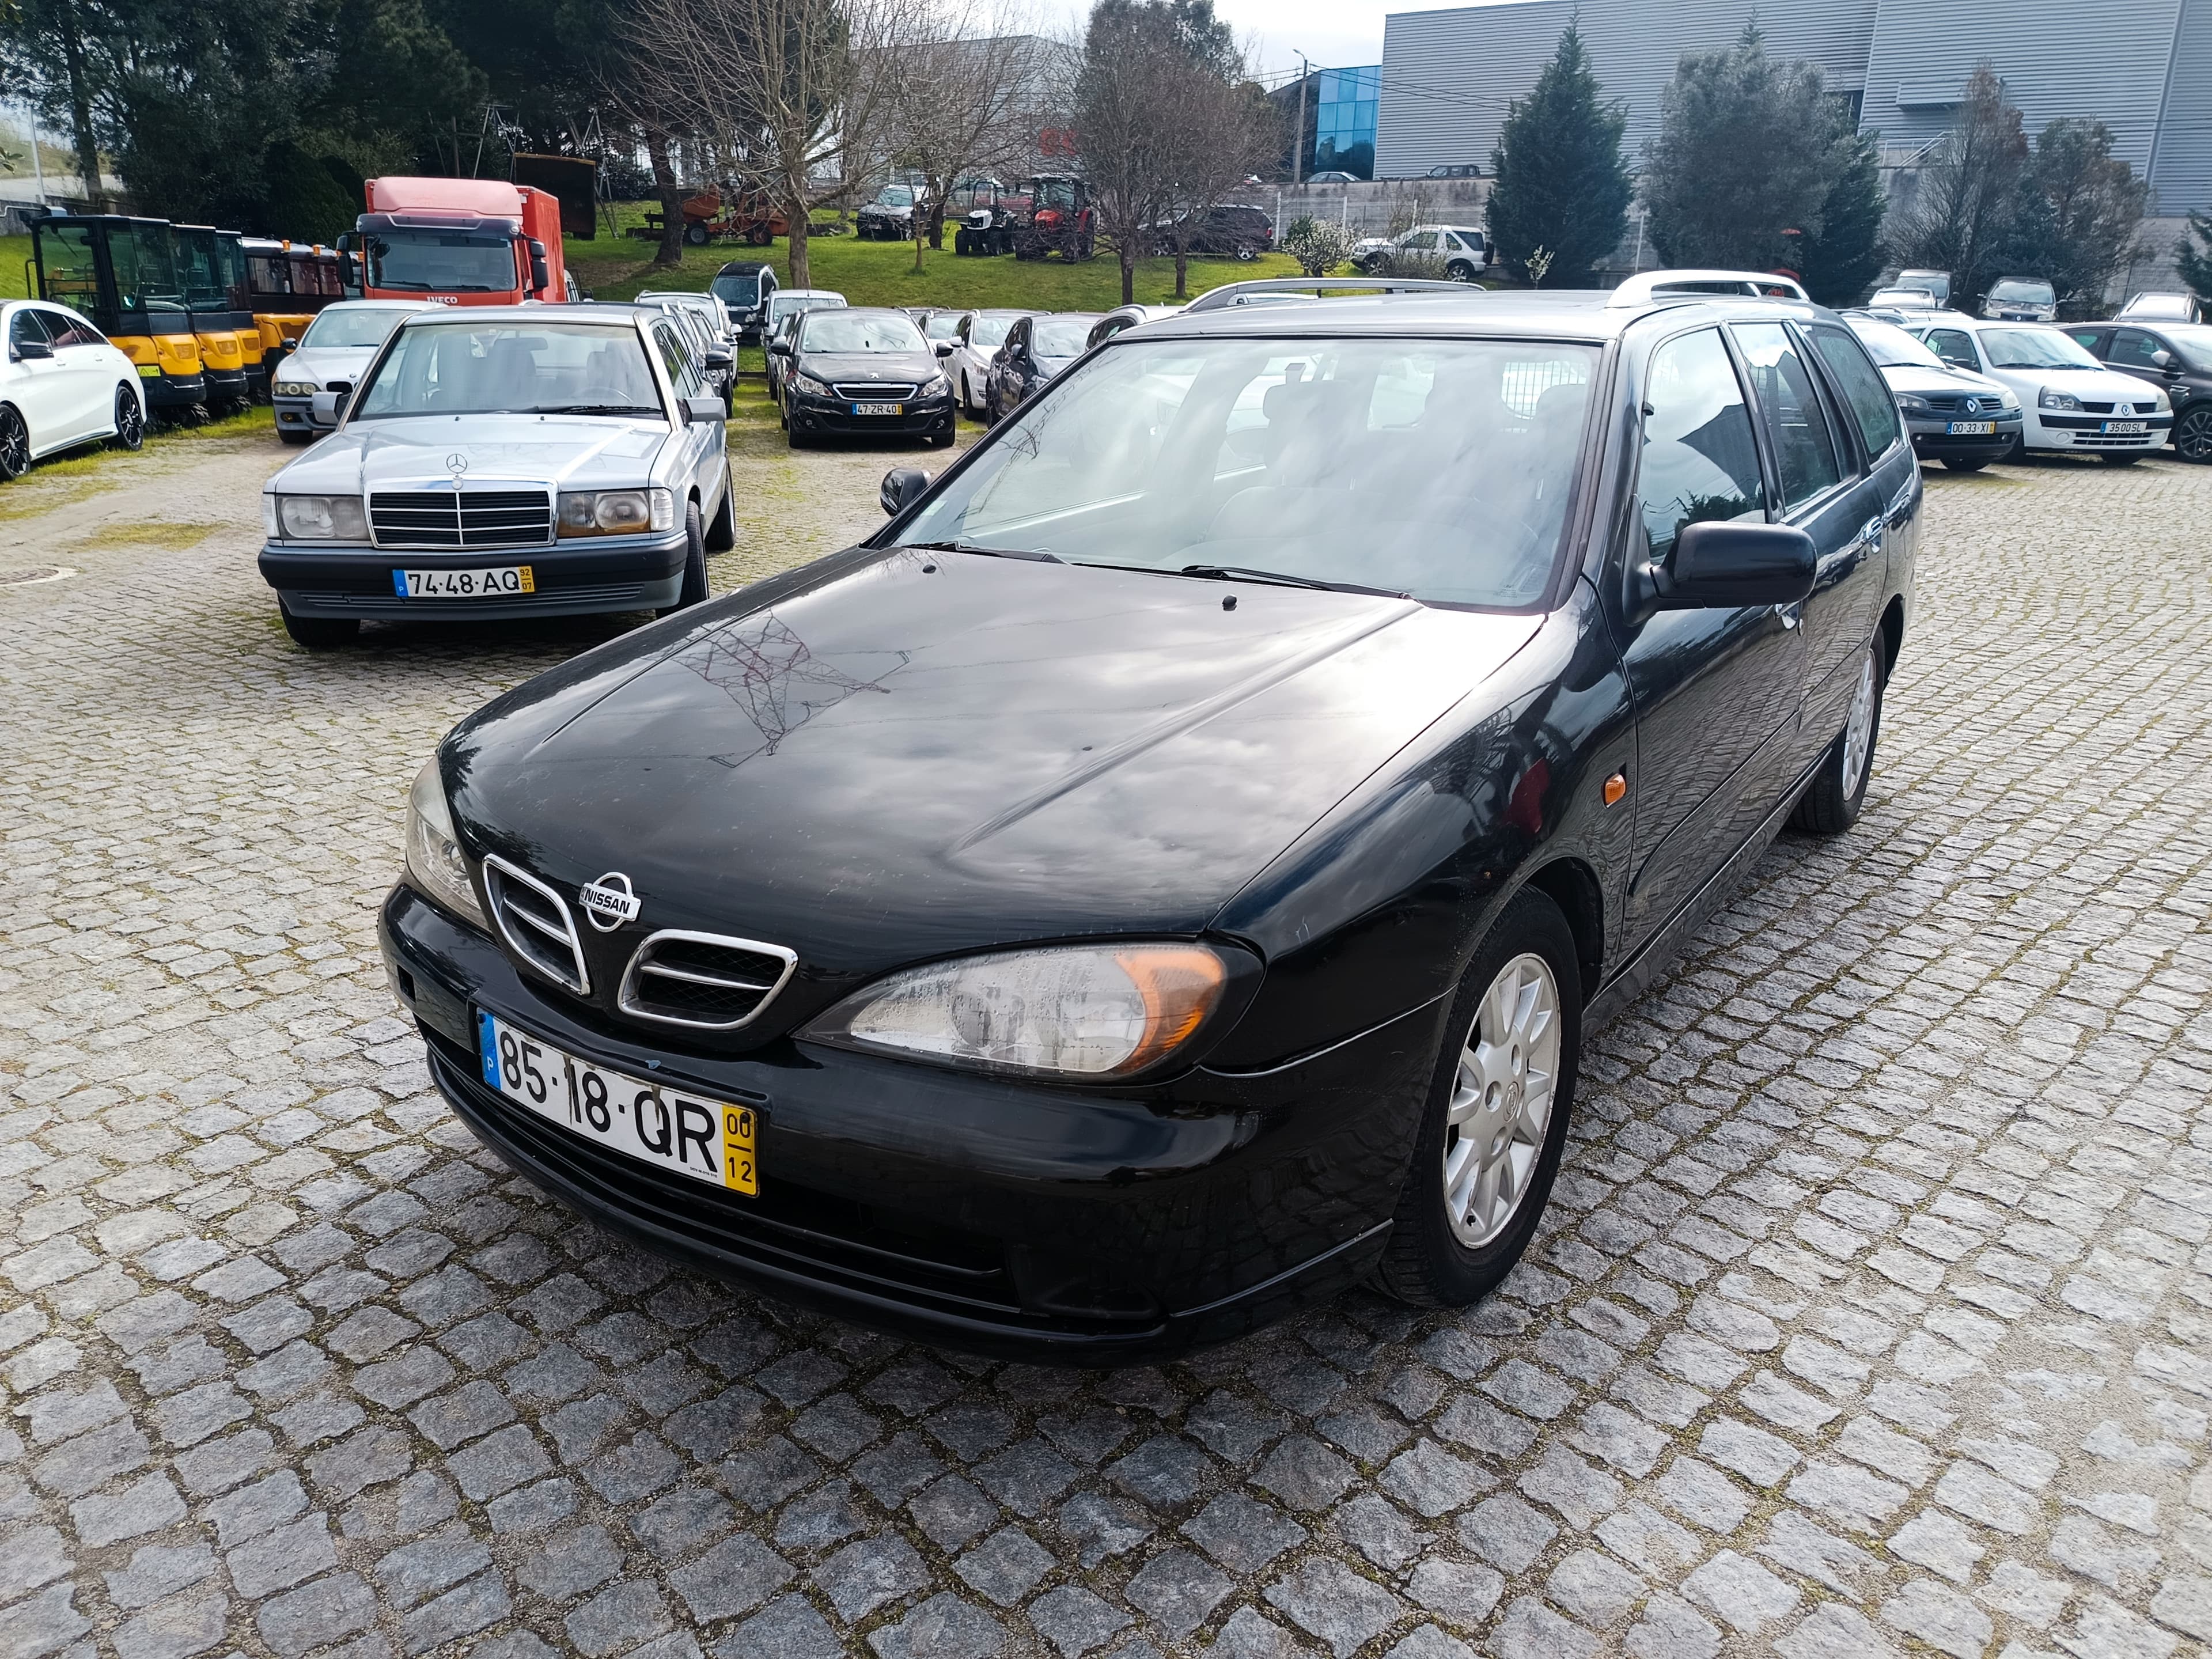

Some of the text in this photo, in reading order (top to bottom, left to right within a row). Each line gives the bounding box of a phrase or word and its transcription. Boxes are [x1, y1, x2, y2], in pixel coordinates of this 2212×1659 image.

[522, 582, 532, 590] 07
[584, 889, 630, 915] NISSAN
[487, 1055, 494, 1071] P
[728, 1156, 752, 1183] 12
